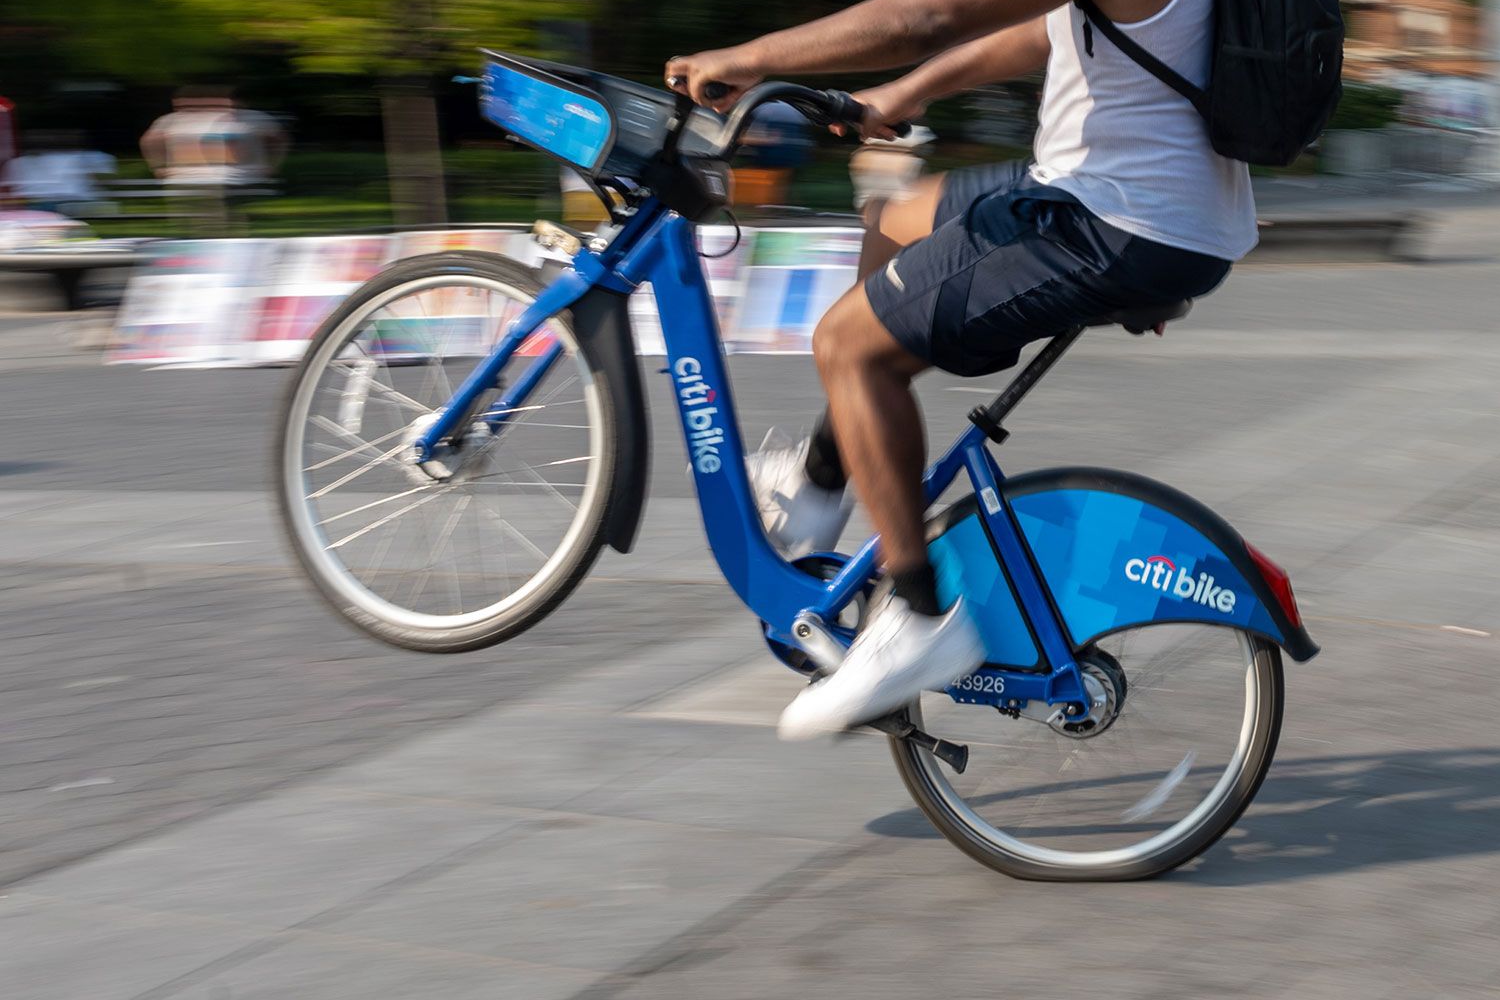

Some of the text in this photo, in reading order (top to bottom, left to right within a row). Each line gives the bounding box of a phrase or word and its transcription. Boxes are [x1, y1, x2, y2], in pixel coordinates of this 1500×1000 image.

[687, 406, 724, 474] bike
[1125, 555, 1236, 614] citi bike
